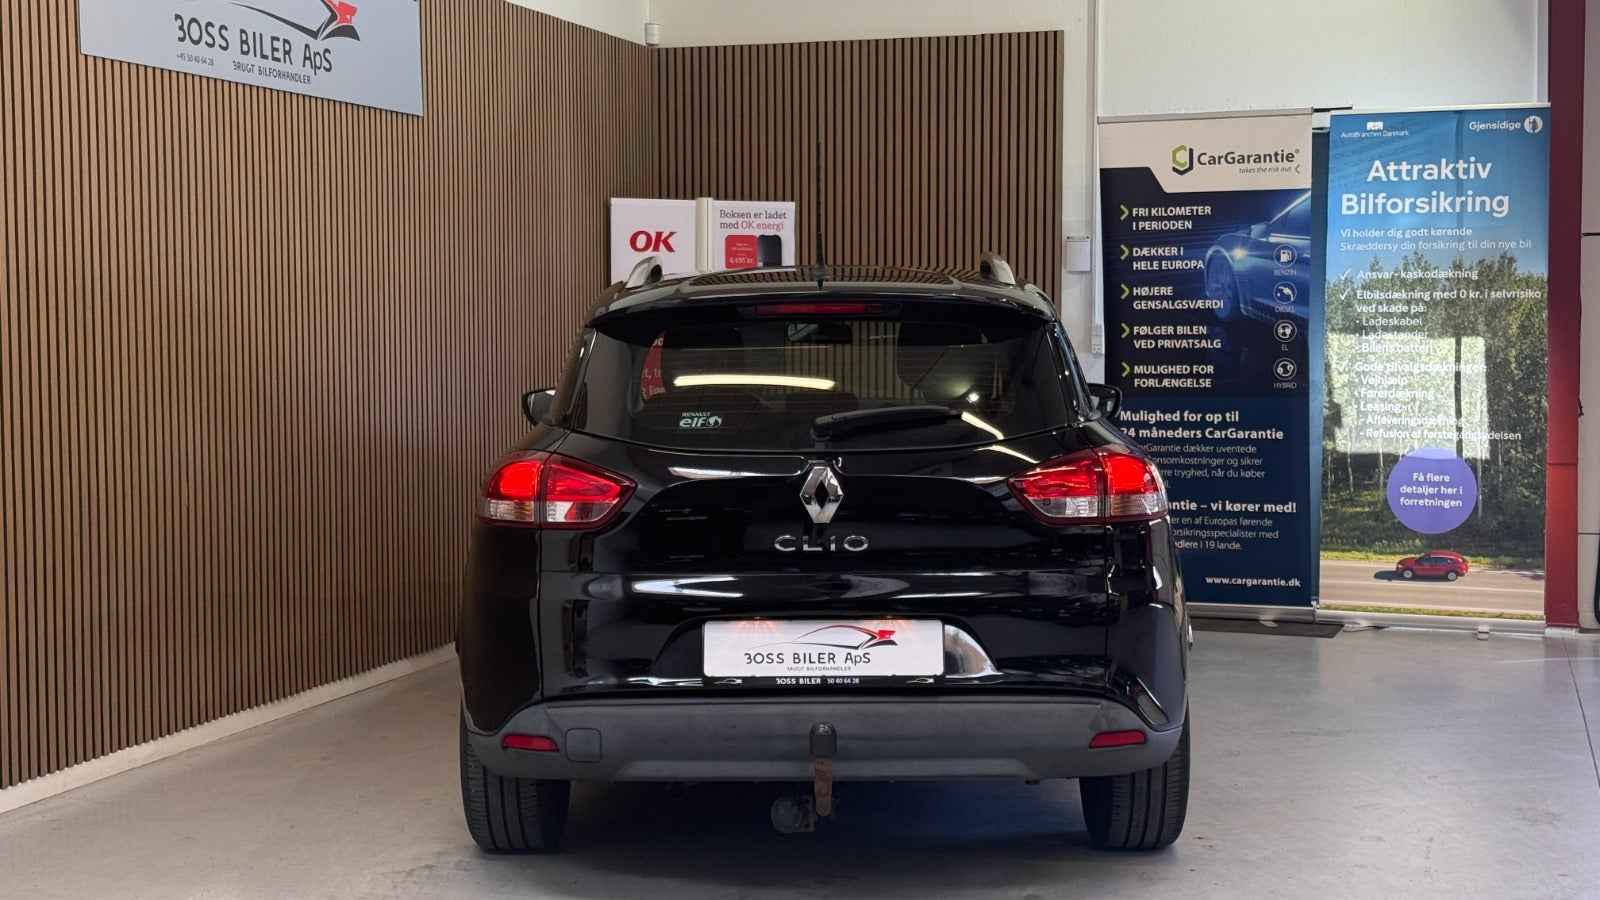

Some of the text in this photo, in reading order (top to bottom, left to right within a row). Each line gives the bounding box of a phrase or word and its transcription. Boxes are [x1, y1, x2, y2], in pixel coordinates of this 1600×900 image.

[240, 28, 293, 65] BILER
[302, 43, 332, 75] ApS
[258, 65, 311, 84] BILFORHANDLER
[1469, 120, 1522, 132] Gjensidige
[1239, 166, 1256, 174] takes
[1367, 156, 1492, 182] Attraktiv
[1341, 190, 1510, 218] Bilforsikring
[720, 210, 788, 220] Boksen er ladet
[1132, 206, 1212, 217] FRI KILOMETER
[720, 220, 784, 232] med OK energi
[1132, 220, 1192, 230] I PERIODEN
[1340, 227, 1472, 239] Vi holder dig godt kørende
[629, 230, 678, 253] OK
[1340, 240, 1532, 252] Skræddersy din forsikring til din nye bil
[1132, 247, 1184, 256] DÆKKER I
[1133, 260, 1204, 270] HELE EUROPA
[1400, 269, 1478, 280] kaskodækning
[1133, 286, 1174, 296] HØJERE
[1356, 289, 1542, 300] Elbilsdækning med 0 kr. i selvrisiko
[1133, 300, 1224, 310] GENSALGSVÆRDI
[1356, 304, 1428, 314] ved skade på:
[1362, 316, 1422, 326] Ladeskabel
[1134, 326, 1207, 336] FØLGER BILEN
[1362, 330, 1429, 340] Ladestander
[1134, 340, 1222, 349] VED PRIVATSALG
[1362, 343, 1394, 352] Bilens
[1134, 365, 1214, 374] MULIGHED FOR
[1355, 362, 1384, 372] Gode
[1134, 378, 1212, 388] FORLÆNGELSE
[679, 416, 707, 428] elf
[1120, 410, 1239, 424] Mulighed for op til
[1139, 426, 1202, 438] måneders
[1205, 428, 1284, 440] CarGarantie
[1183, 444, 1214, 453] dækker
[1216, 444, 1257, 454] uventede
[1226, 458, 1239, 467] og
[1240, 457, 1263, 466] sikrer
[1174, 468, 1210, 479] tryghed,
[1212, 468, 1225, 478] når
[1227, 468, 1239, 478] du
[1240, 469, 1266, 478] køber
[1413, 472, 1450, 482] Få flere
[1400, 485, 1463, 496] detaljer her i
[1210, 500, 1222, 512] vi
[1225, 500, 1260, 512] kører
[1264, 502, 1296, 514] med!
[1400, 498, 1462, 508] forretningen
[1194, 516, 1202, 524] af
[1204, 516, 1238, 526] Europas
[1240, 516, 1274, 526] førende
[1258, 530, 1280, 539] med
[774, 535, 868, 552] CLIO
[1205, 541, 1216, 549] 19
[1216, 542, 1242, 550] lande.
[1206, 576, 1301, 588] www.cargarantie.dk
[792, 652, 836, 664] BILER
[844, 652, 871, 666] ApS
